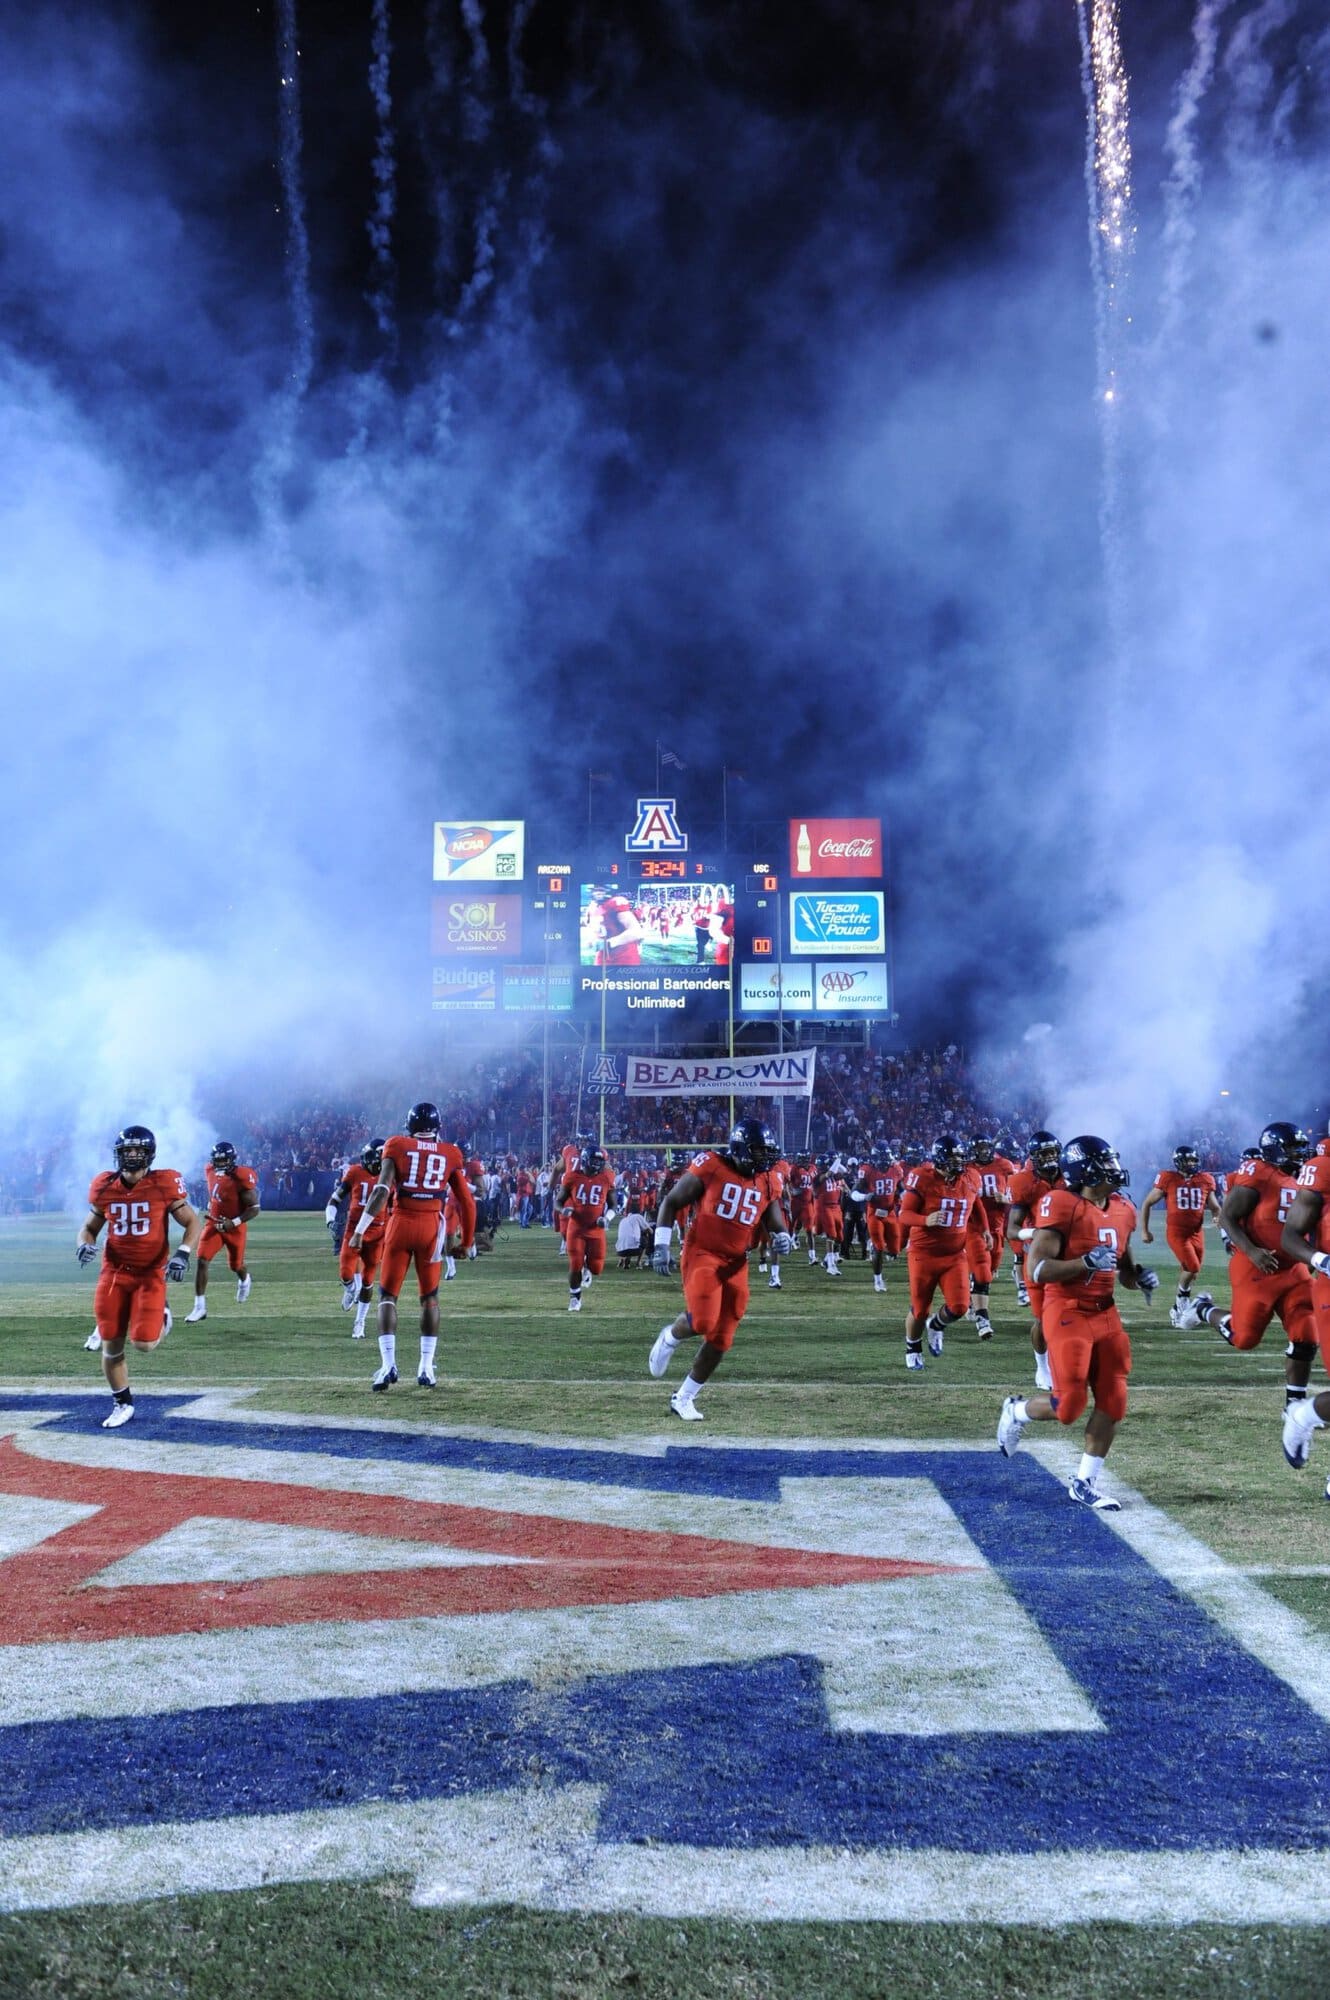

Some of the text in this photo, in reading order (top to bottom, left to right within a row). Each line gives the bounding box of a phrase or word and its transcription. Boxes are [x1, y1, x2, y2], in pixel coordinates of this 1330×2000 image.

[452, 839, 485, 853] NCAA
[496, 864, 515, 873] 10
[537, 865, 571, 875] ARIZONA
[611, 863, 618, 875] 3
[641, 861, 685, 877] 3:24
[696, 863, 703, 875] 3
[753, 864, 770, 873] USC
[816, 901, 859, 913] Tucson
[448, 902, 506, 930] SOL
[821, 913, 871, 924] Electric
[448, 930, 506, 942] CASINOS
[826, 924, 871, 935] Power
[432, 967, 496, 988] Budget
[822, 972, 854, 991] AAA
[582, 978, 731, 991] Professional Bartenders
[744, 988, 811, 999] tucson.com
[838, 993, 883, 1003] Insurance
[627, 996, 686, 1009] Unlimited
[403, 1151, 446, 1189] 18
[576, 1184, 602, 1205] 46
[875, 1178, 894, 1201] 83
[716, 1182, 762, 1225] 95
[1176, 1187, 1202, 1210] 60
[1040, 1196, 1051, 1217] 2
[110, 1202, 151, 1237] 35
